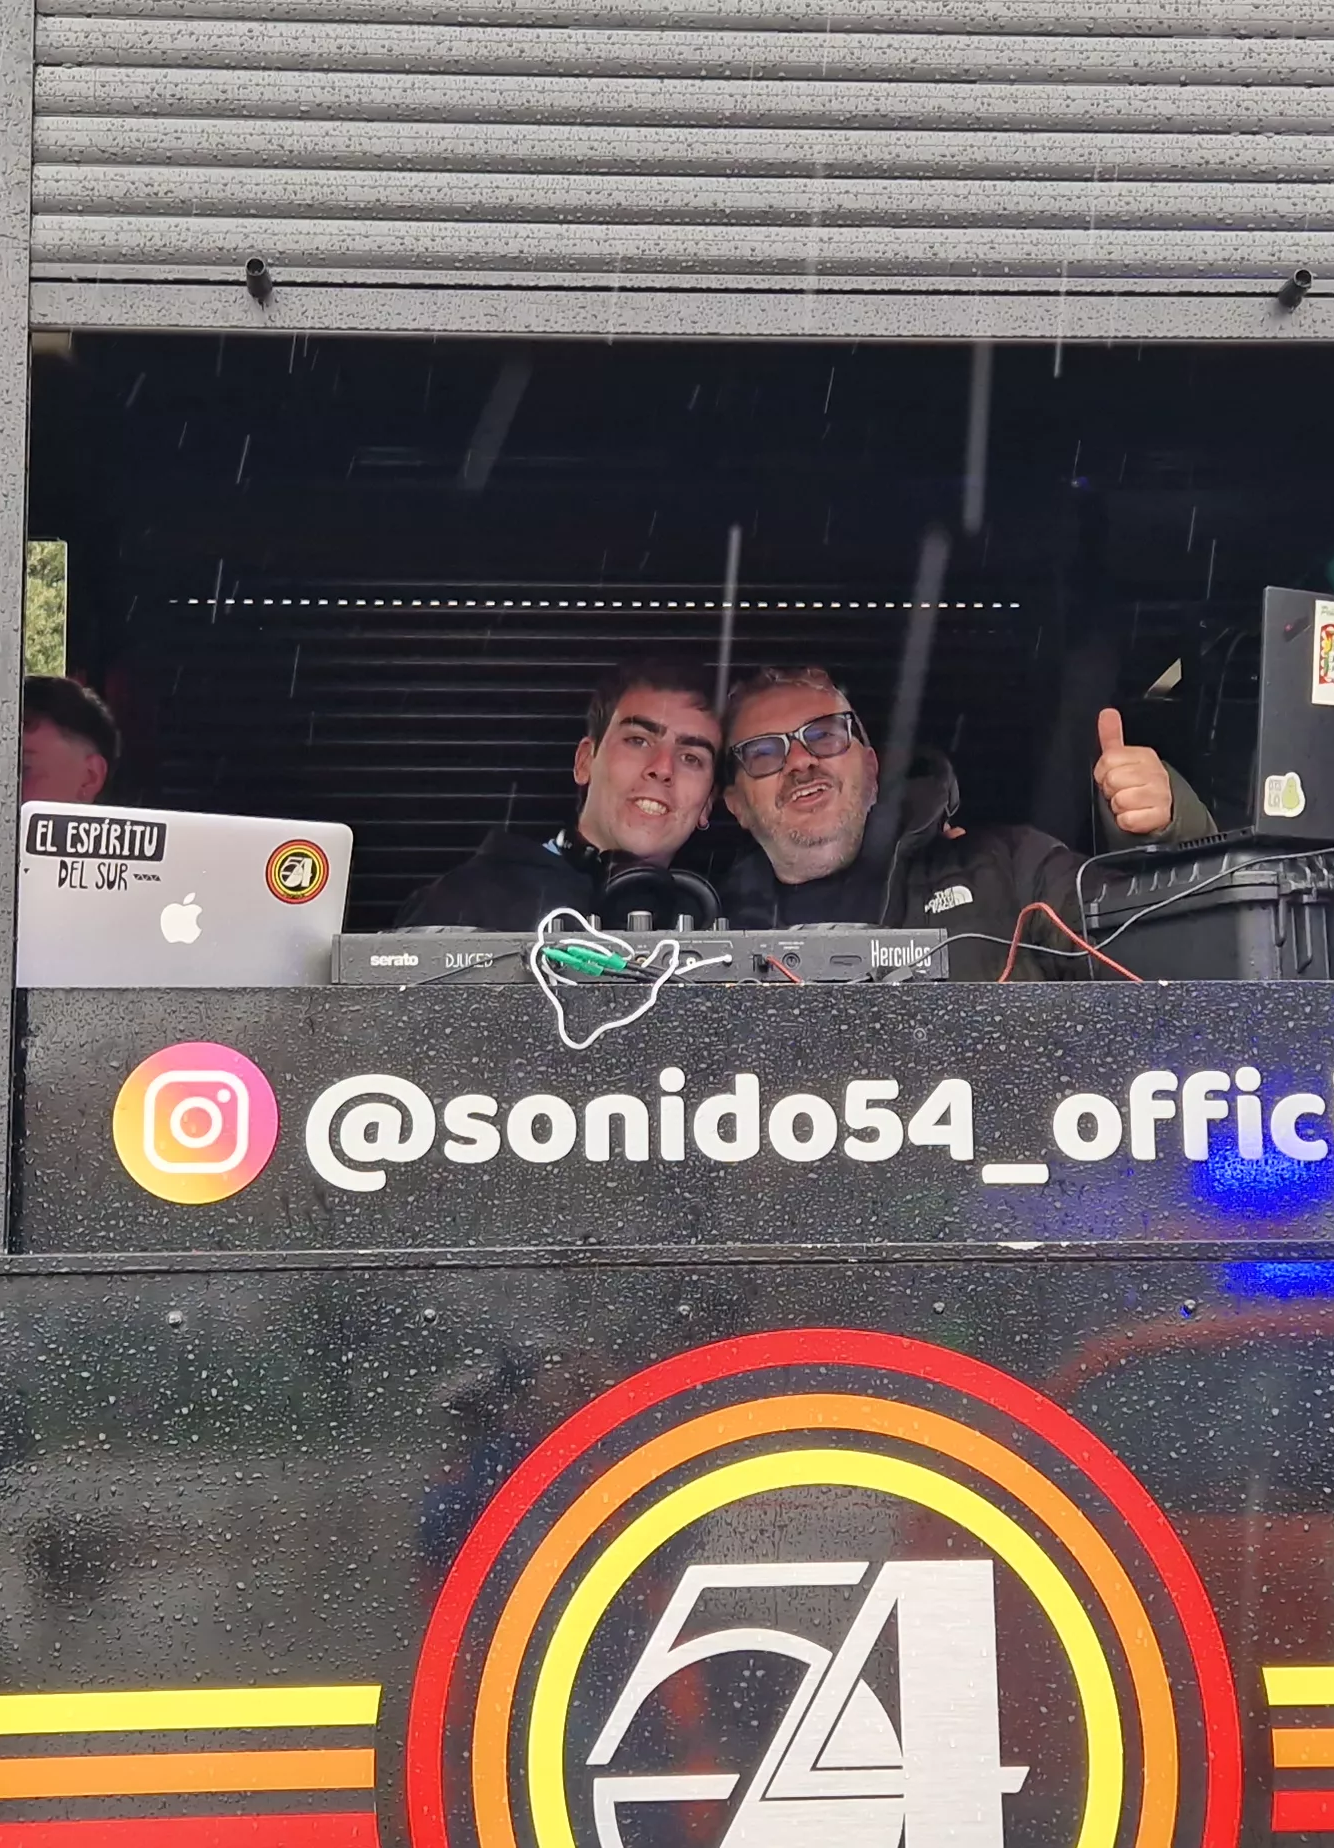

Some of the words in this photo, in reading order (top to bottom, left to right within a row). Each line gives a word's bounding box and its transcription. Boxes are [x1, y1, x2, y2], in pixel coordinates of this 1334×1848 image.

[35, 819, 58, 852] EL
[58, 859, 89, 889] DEL
[95, 861, 129, 892] SUR
[370, 952, 419, 967] serato
[871, 939, 932, 968] Hercules
